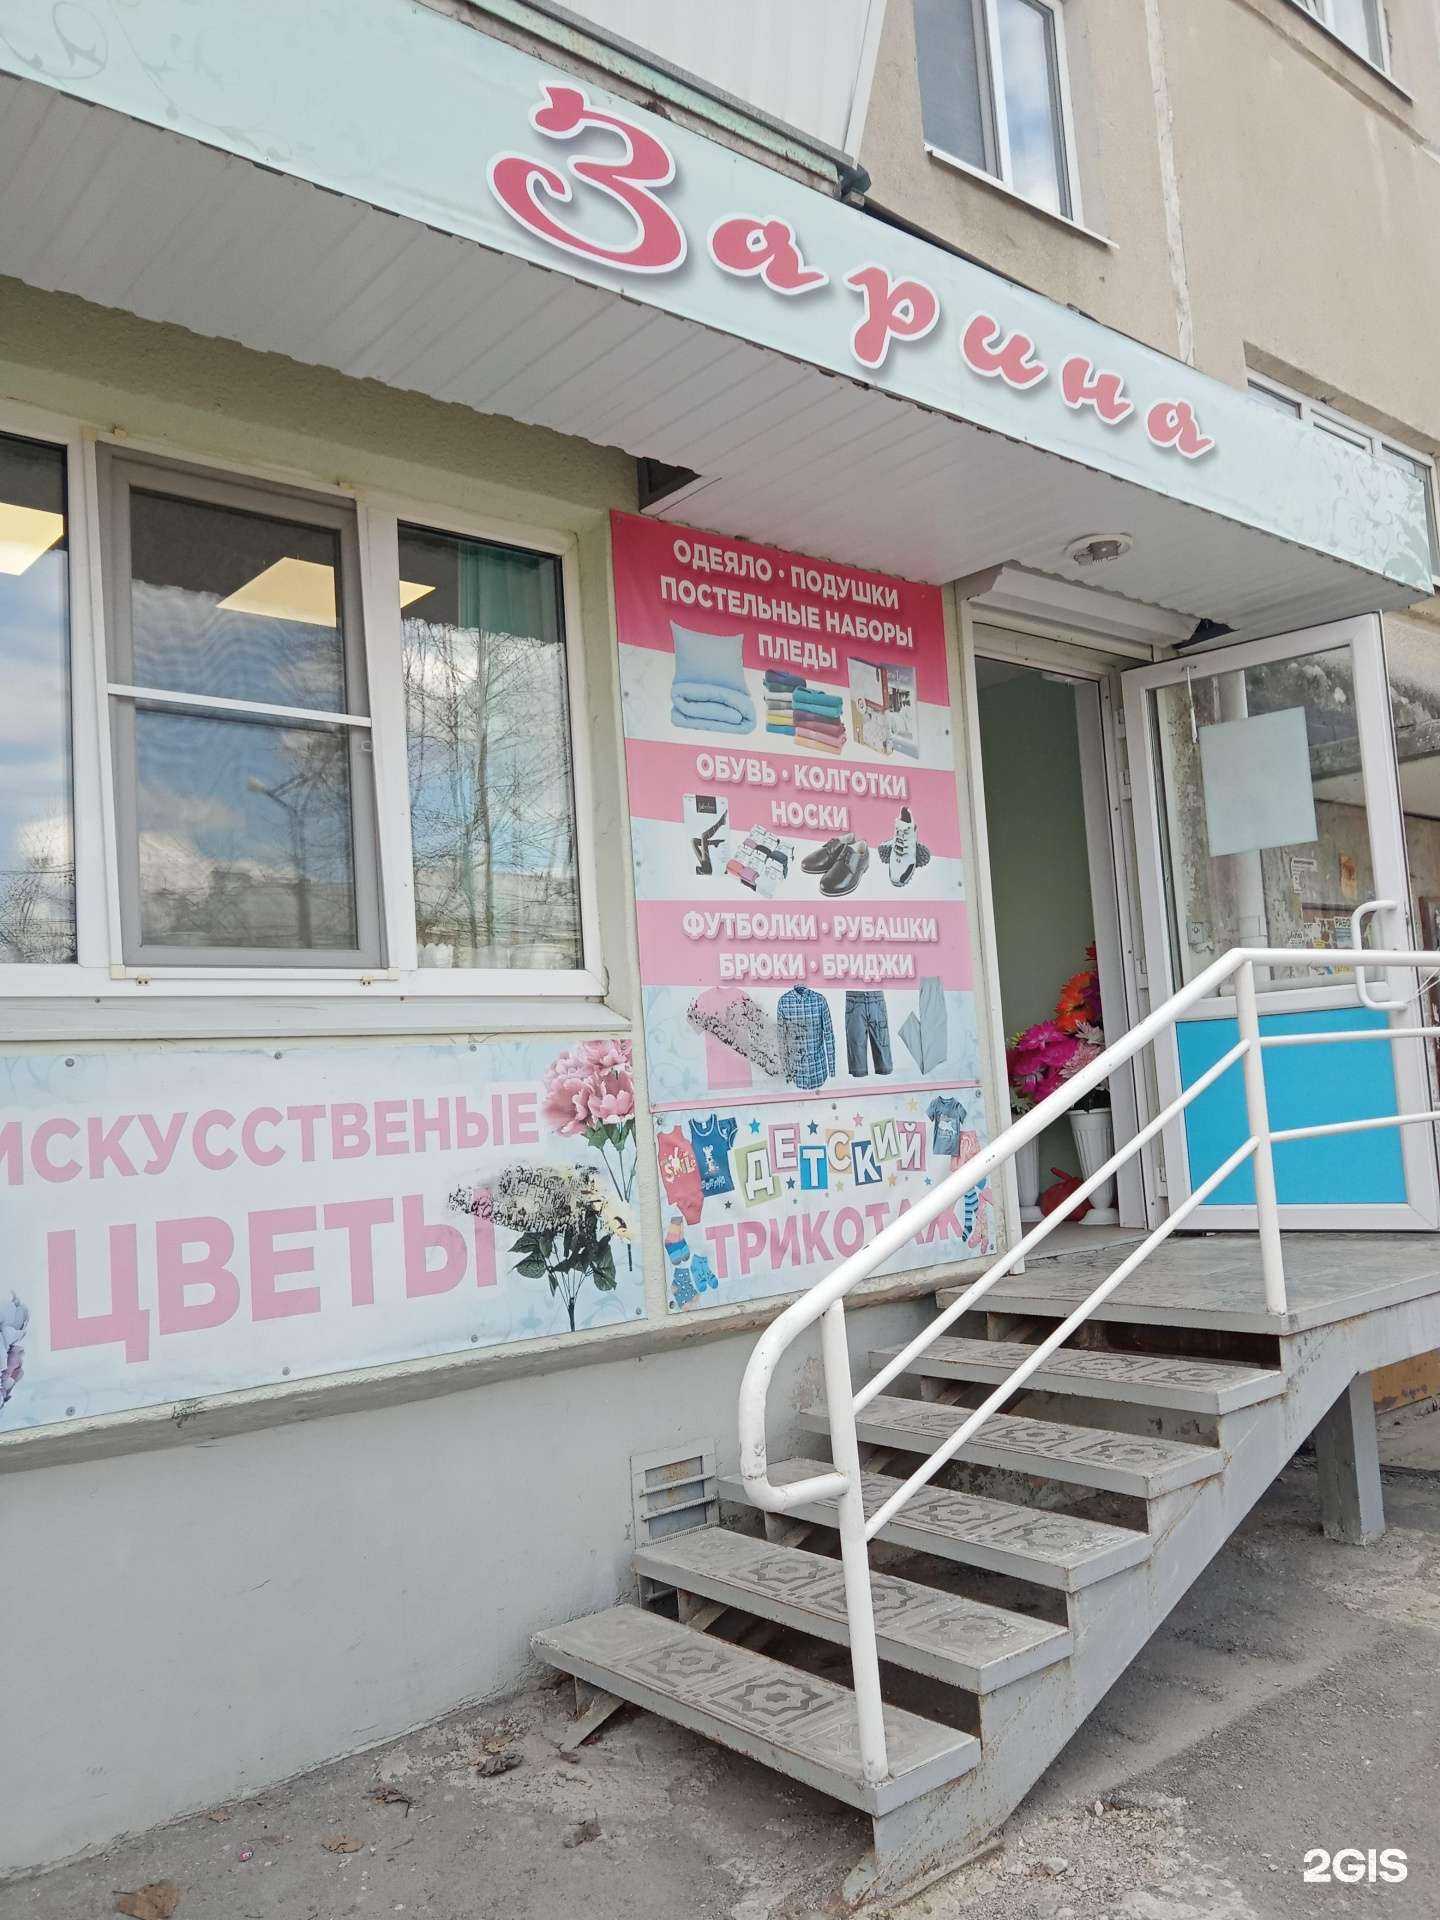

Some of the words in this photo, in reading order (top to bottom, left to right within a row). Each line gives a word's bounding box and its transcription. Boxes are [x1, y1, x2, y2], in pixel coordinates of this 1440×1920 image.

[487, 81, 1215, 457] Зарина
[673, 539, 772, 581] ОДЕЯЛО
[790, 565, 899, 609] ПОДУШКИ
[660, 575, 820, 630] ПОСТЕЛЬНЫЕ
[826, 609, 913, 648] НАБОРЫ
[758, 633, 837, 669] ПЛЕДЫ
[696, 753, 777, 785] ОБУВЬ
[794, 764, 908, 799] КОЛГОТКИ
[771, 801, 849, 830] НОСКИ
[682, 911, 817, 940] ФУТБОЛКИ
[833, 915, 938, 942] РУБАШКИ
[719, 953, 806, 979] БРЮКИ
[822, 953, 914, 983] БРИДЖИ
[744, 1118, 923, 1202] ДЕТСКИЙ
[46, 1188, 498, 1364] ЦВЕТЫ
